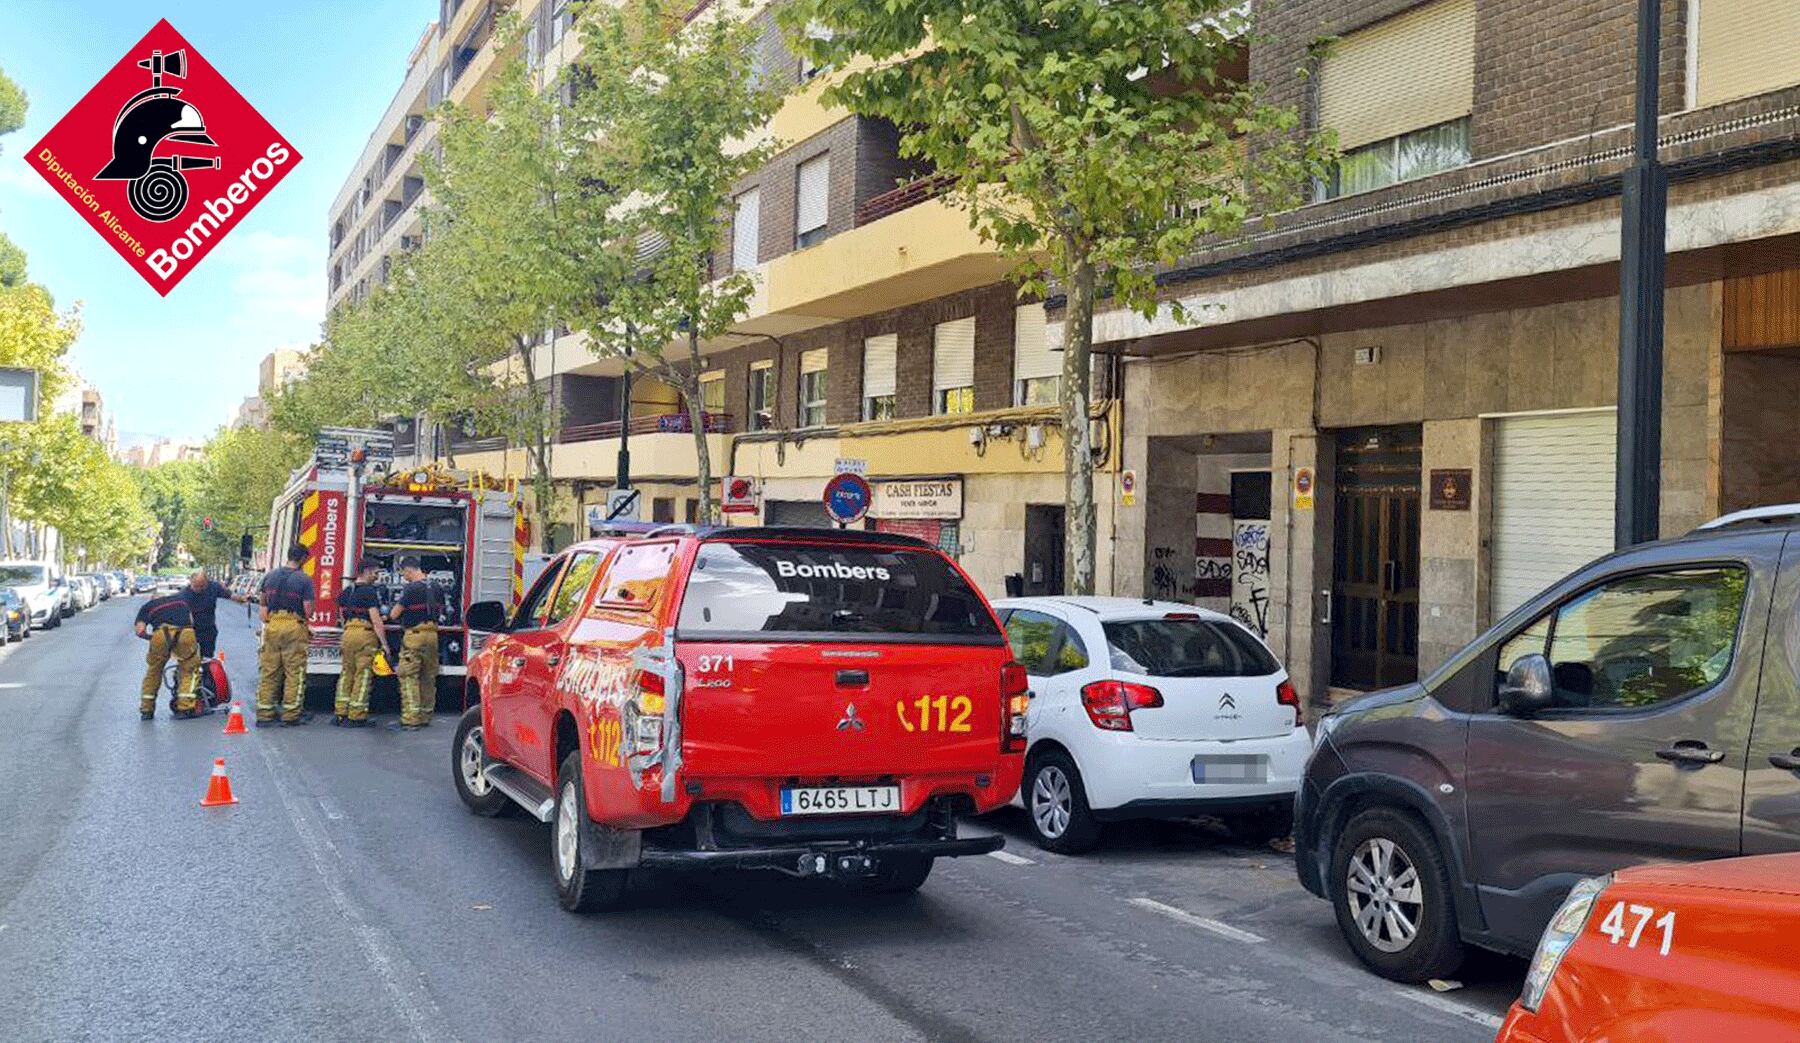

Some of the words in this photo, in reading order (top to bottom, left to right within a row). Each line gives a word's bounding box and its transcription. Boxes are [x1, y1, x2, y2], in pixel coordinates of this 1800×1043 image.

[886, 485, 911, 498] CASH
[914, 483, 953, 497] FIESTAS
[320, 498, 339, 566] Bombers
[776, 561, 891, 581] Bombers
[698, 655, 734, 673] 371
[914, 695, 972, 731] 112
[597, 718, 621, 768] 112
[799, 790, 848, 809] 6465
[855, 789, 891, 808] LTJ
[1600, 901, 1675, 956] 471
